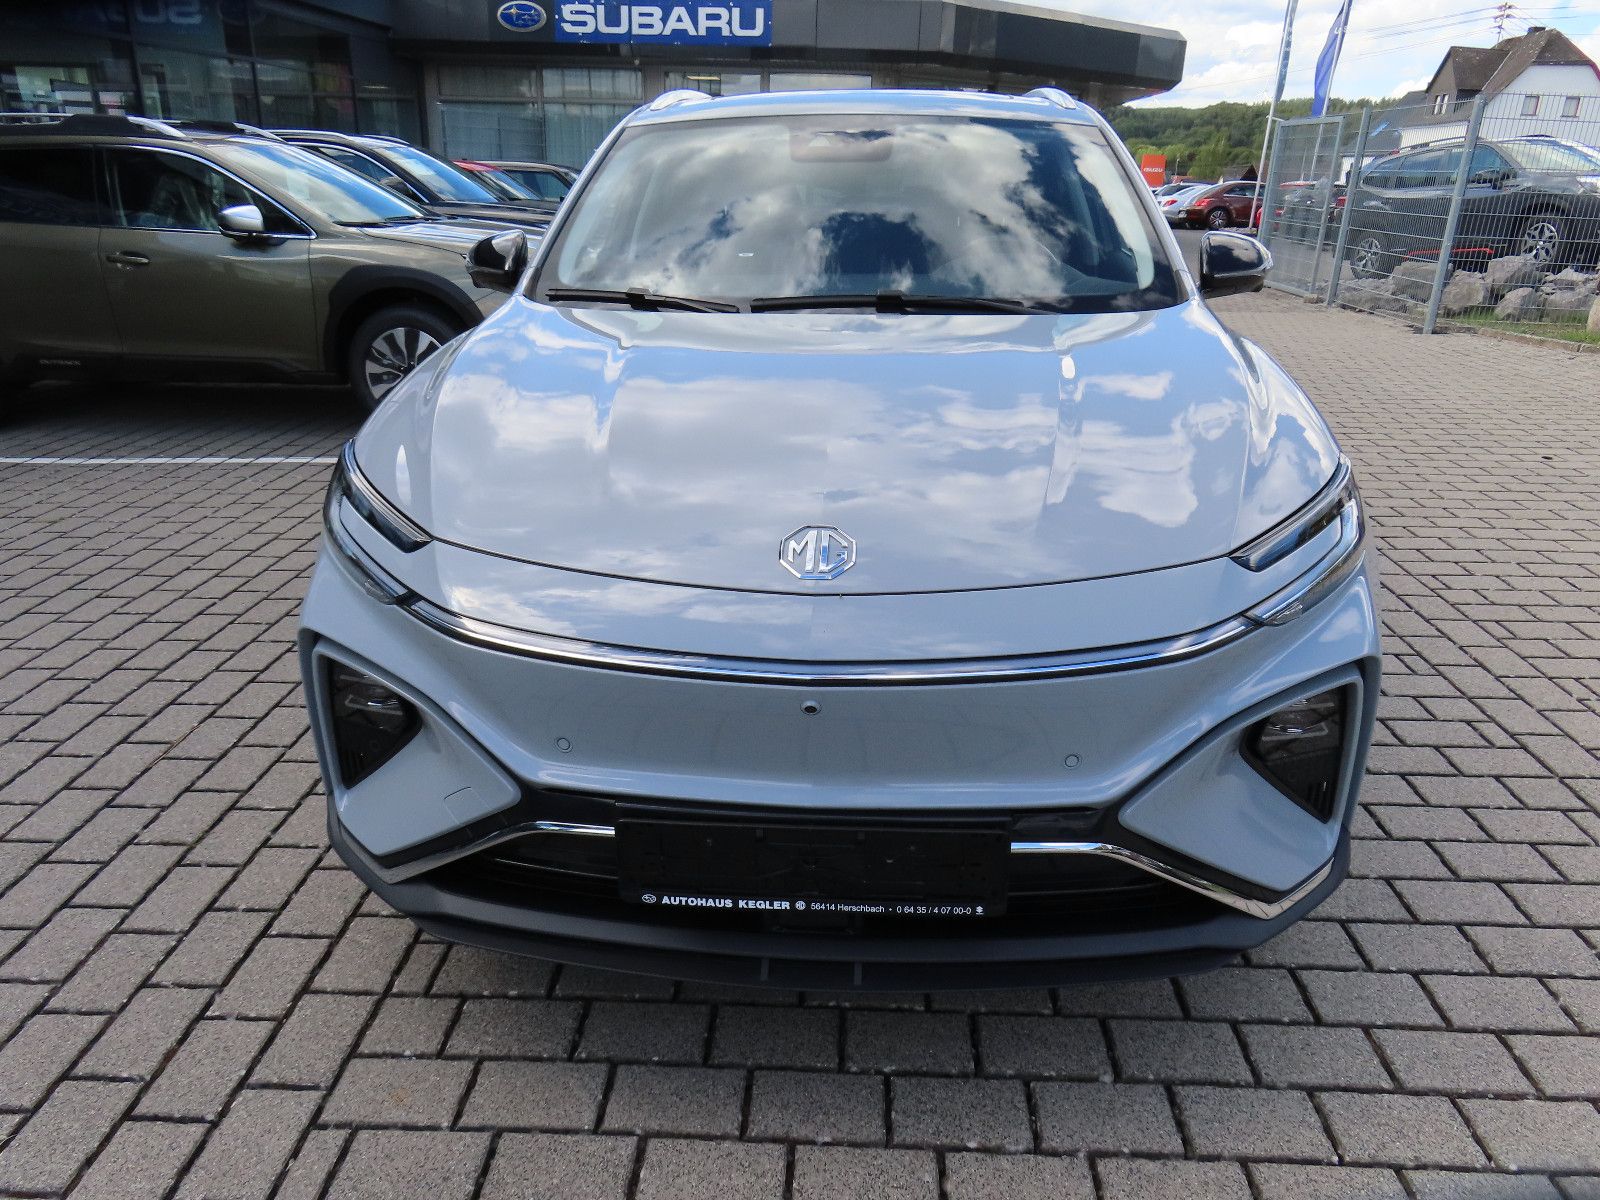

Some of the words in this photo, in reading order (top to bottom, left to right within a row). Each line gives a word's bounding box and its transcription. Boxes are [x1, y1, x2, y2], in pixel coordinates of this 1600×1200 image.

[561, 3, 765, 37] SUBARU
[787, 529, 849, 573] MG
[661, 895, 733, 908] AUTOHAUS
[738, 899, 791, 910] KEGLER
[810, 902, 836, 911] 56414
[837, 903, 885, 913] Herschbach
[904, 905, 914, 914] 64
[916, 906, 927, 914] 35
[941, 906, 951, 915] 07
[953, 906, 972, 915] 00-0
